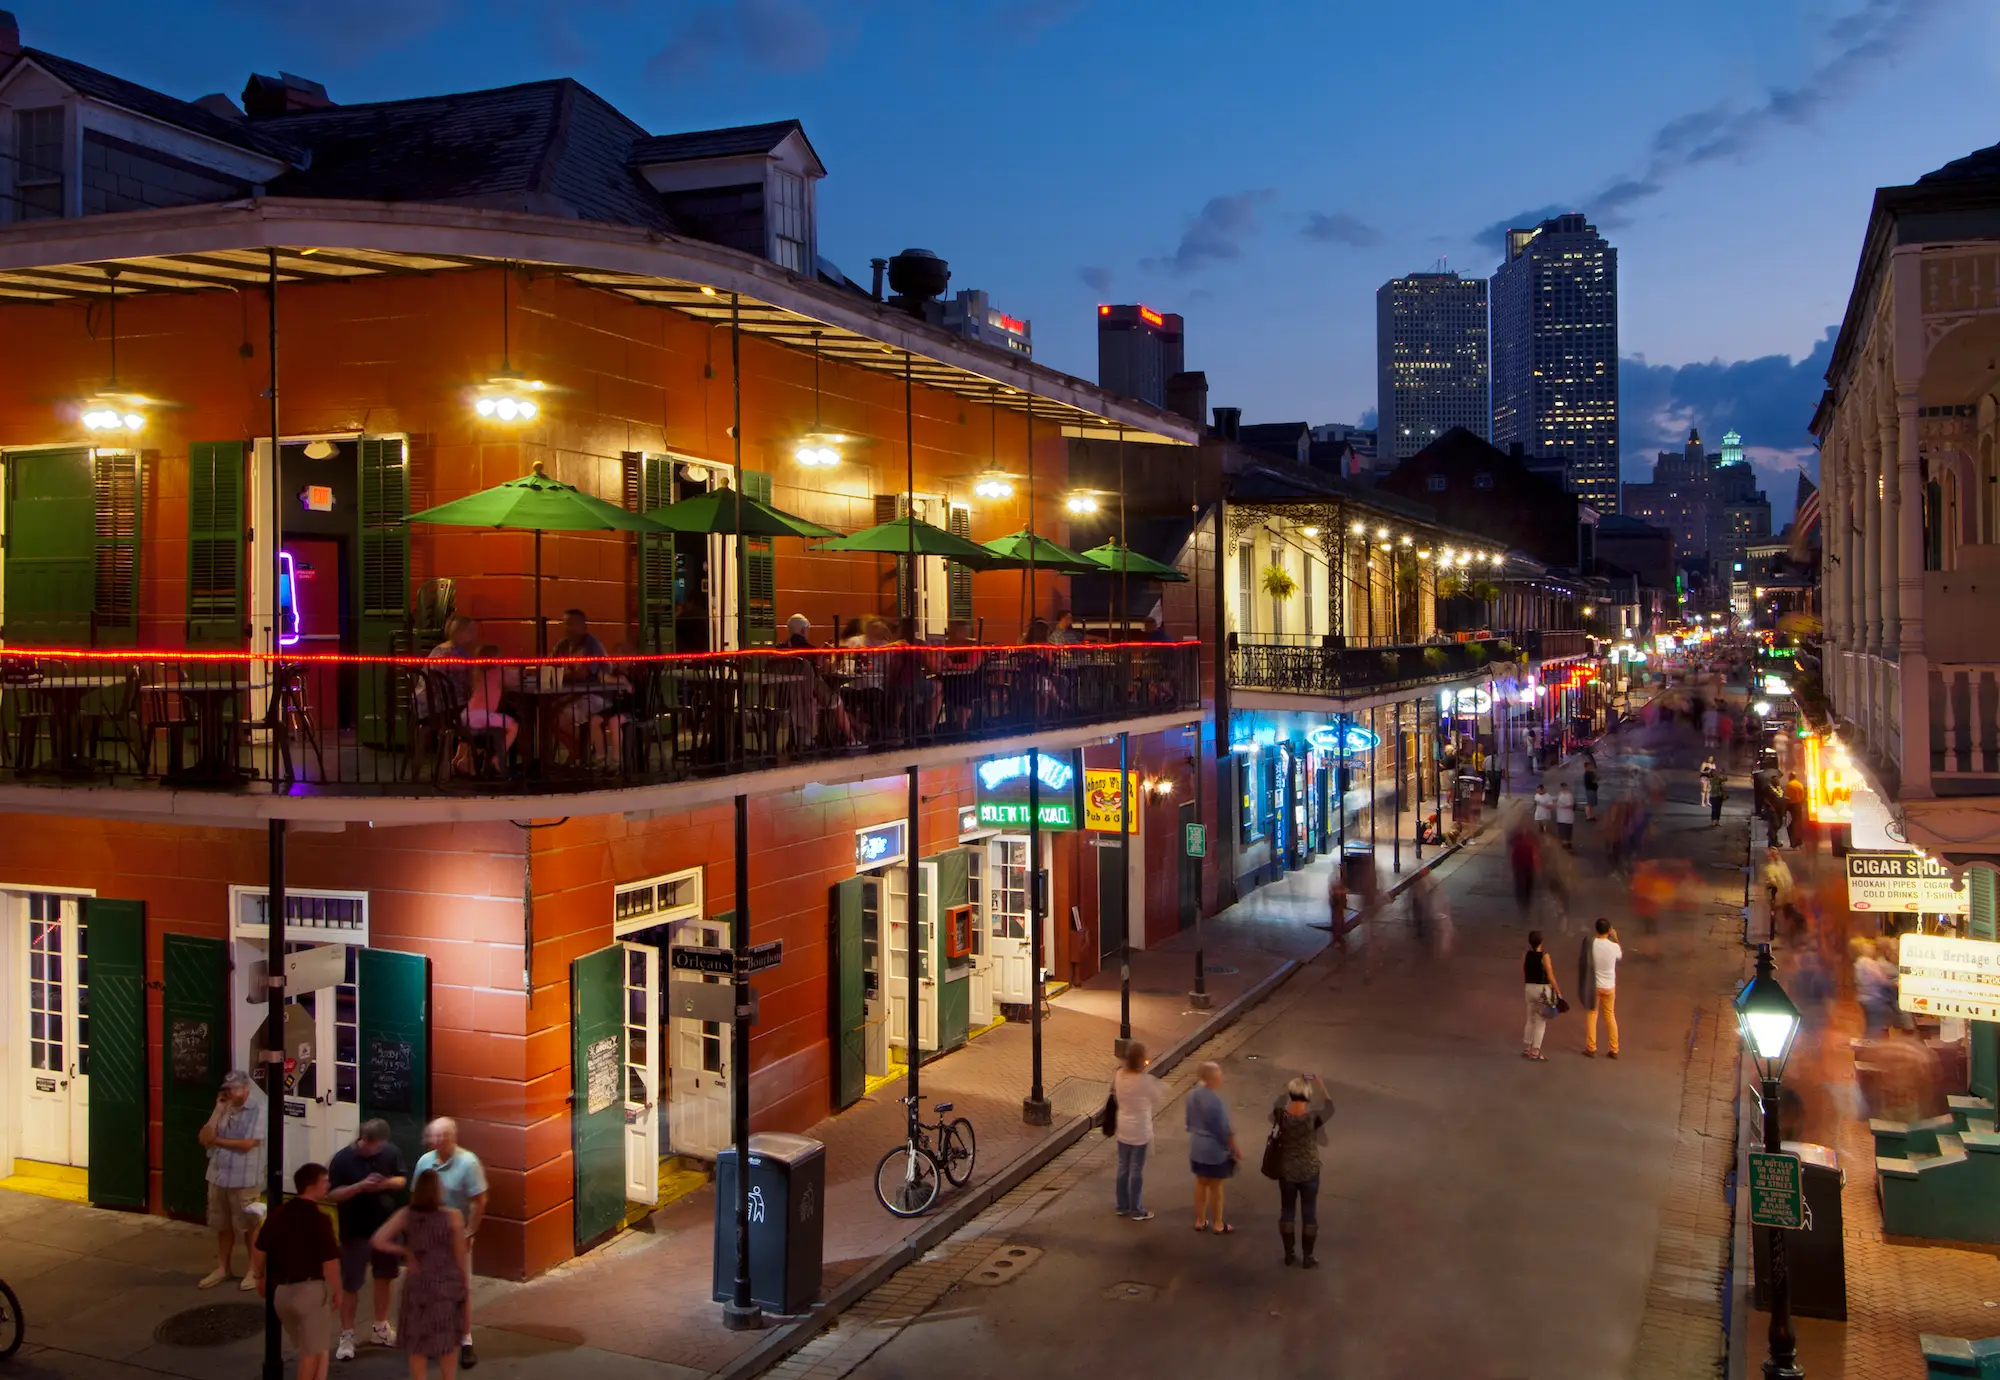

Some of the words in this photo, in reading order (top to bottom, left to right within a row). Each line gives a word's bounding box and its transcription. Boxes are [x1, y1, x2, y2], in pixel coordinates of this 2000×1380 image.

[1853, 859, 1901, 875] CIGAR
[1852, 880, 1886, 888] HOOKAH
[1893, 881, 1917, 889] PIPES
[1863, 890, 1885, 898] COLD
[1888, 890, 1918, 899] DRINKS
[1926, 891, 1965, 900] T-SHIRTS
[677, 953, 729, 970] Orleans
[748, 952, 781, 971] Bourbon
[1943, 949, 1990, 969] Heritage
[1765, 1159, 1794, 1169] BOTTLES
[1769, 1167, 1792, 1175] GLASS
[1758, 1173, 1790, 1182] ALLOWED
[1768, 1181, 1793, 1189] STREET
